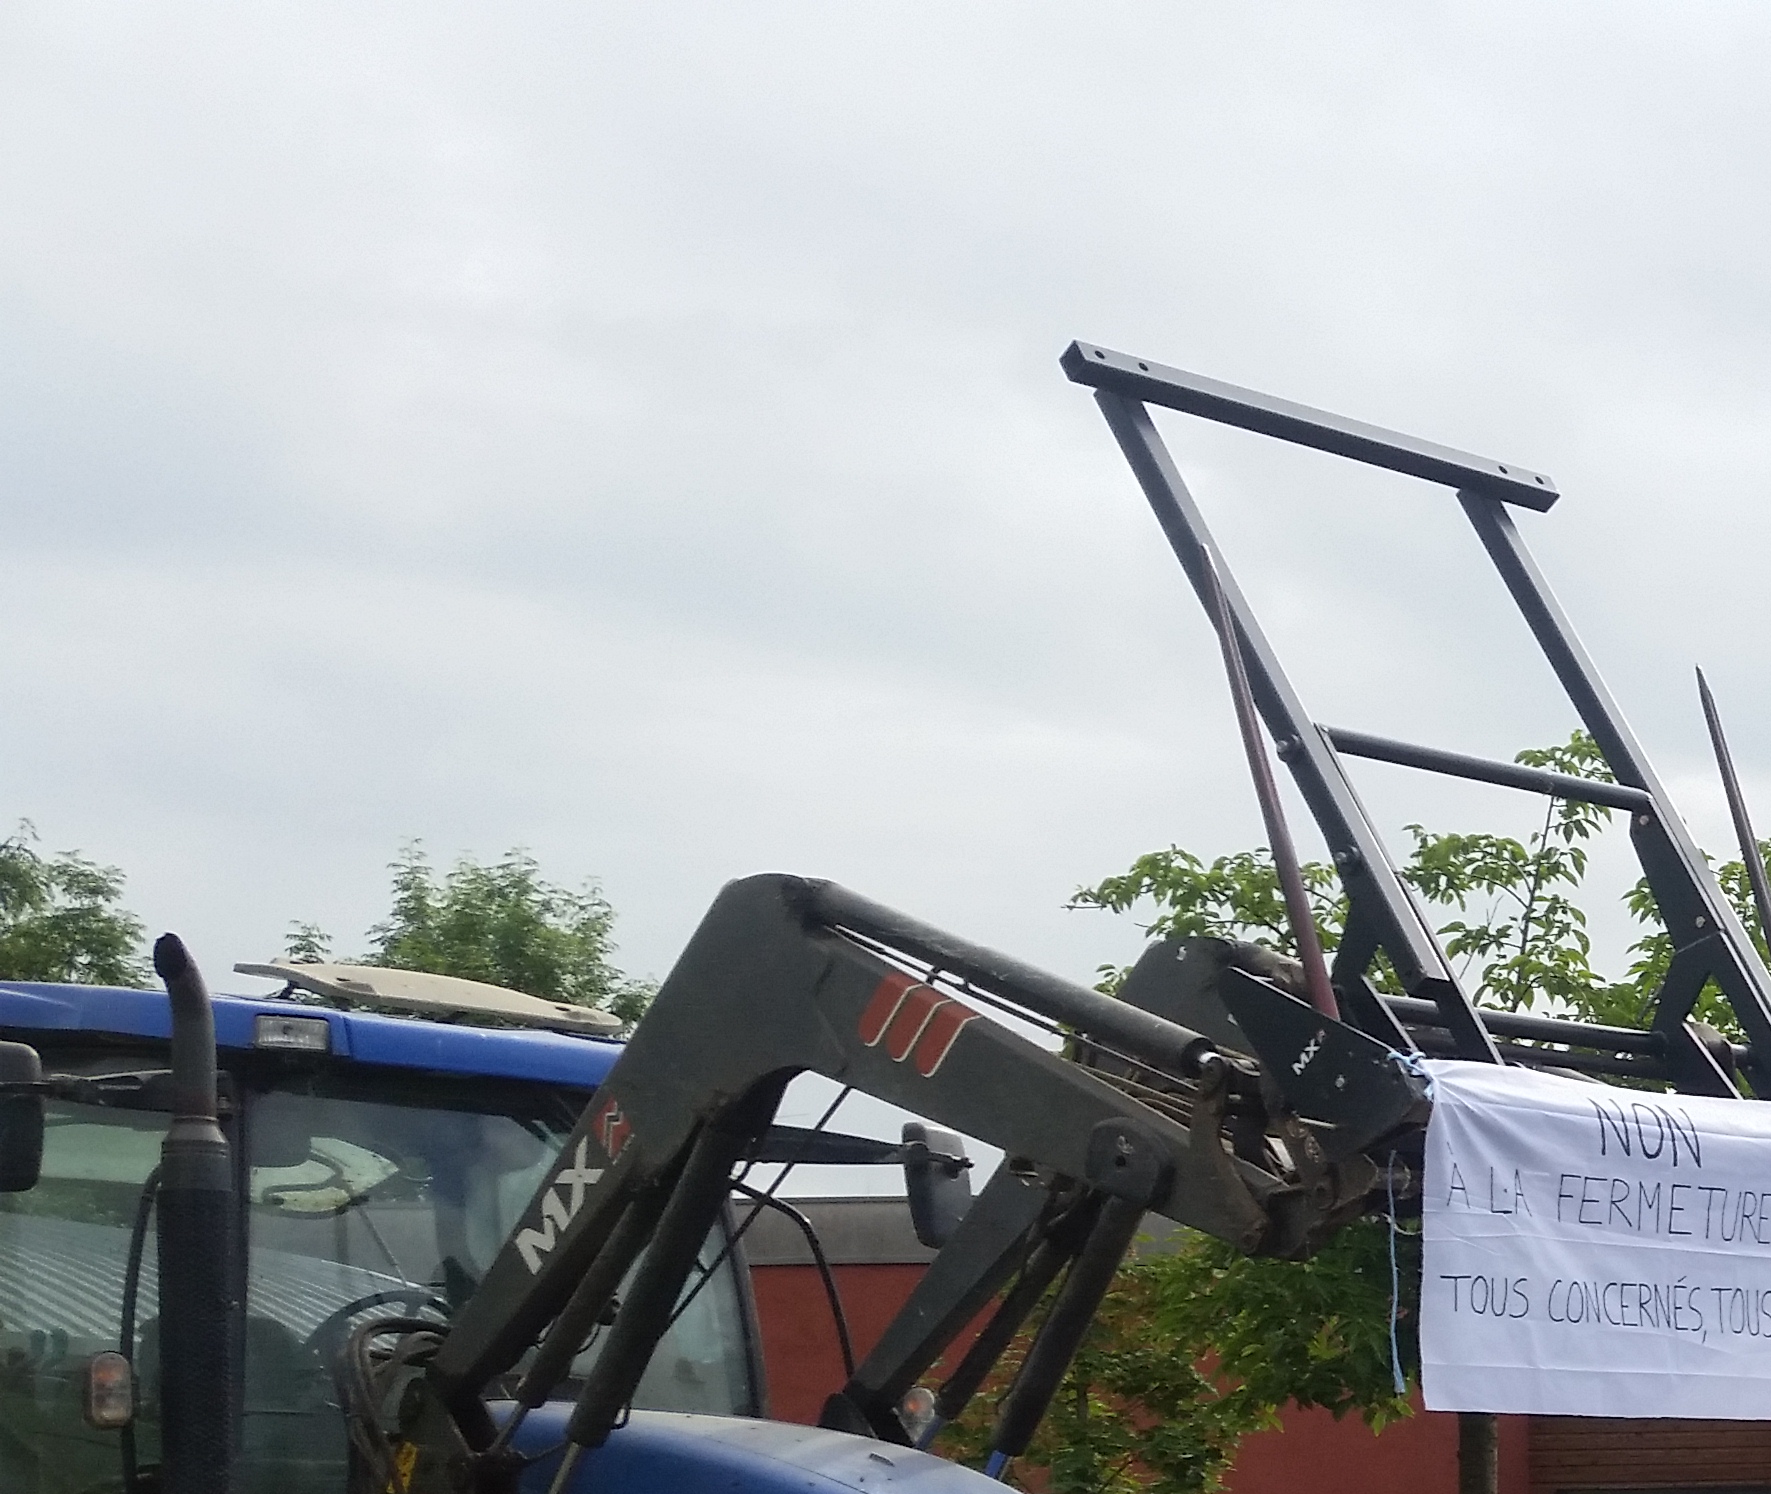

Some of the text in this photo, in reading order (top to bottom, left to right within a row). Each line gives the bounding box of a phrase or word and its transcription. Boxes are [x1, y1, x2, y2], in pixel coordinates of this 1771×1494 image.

[1589, 1097, 1702, 1168] NON
[515, 1135, 604, 1276] MX
[1490, 1166, 1532, 1217] LA
[1440, 1274, 1529, 1318] TOUS
